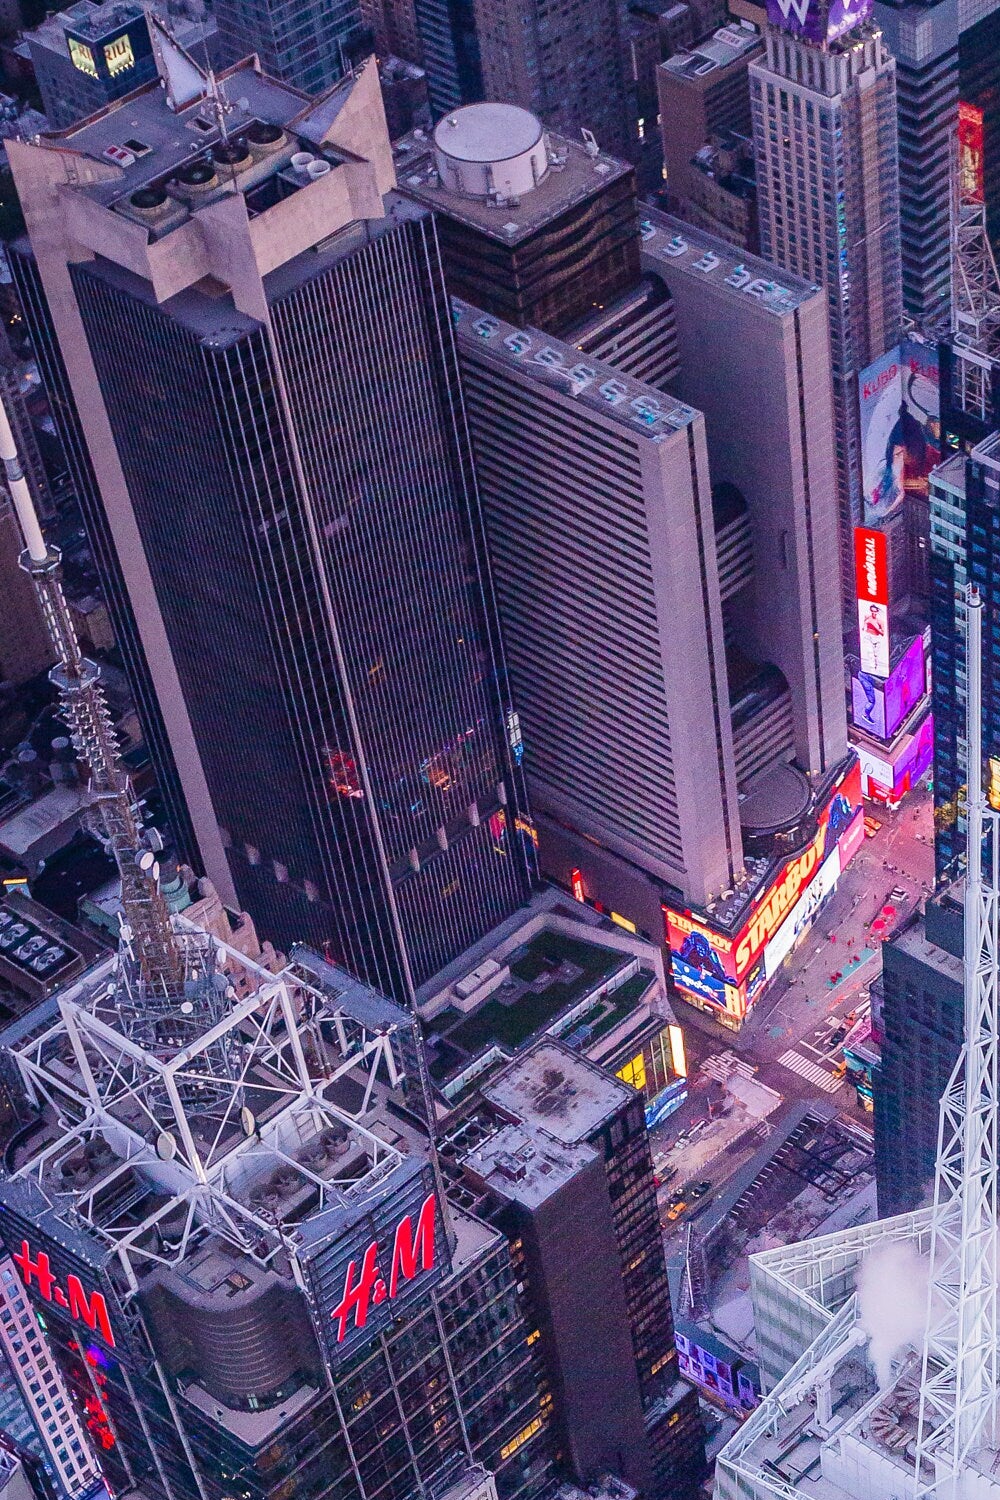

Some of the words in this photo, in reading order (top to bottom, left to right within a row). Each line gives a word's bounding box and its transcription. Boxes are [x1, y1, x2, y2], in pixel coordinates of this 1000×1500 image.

[736, 821, 828, 974] STARBOY
[14, 1240, 115, 1348] H&M
[331, 1193, 435, 1342] H&M
